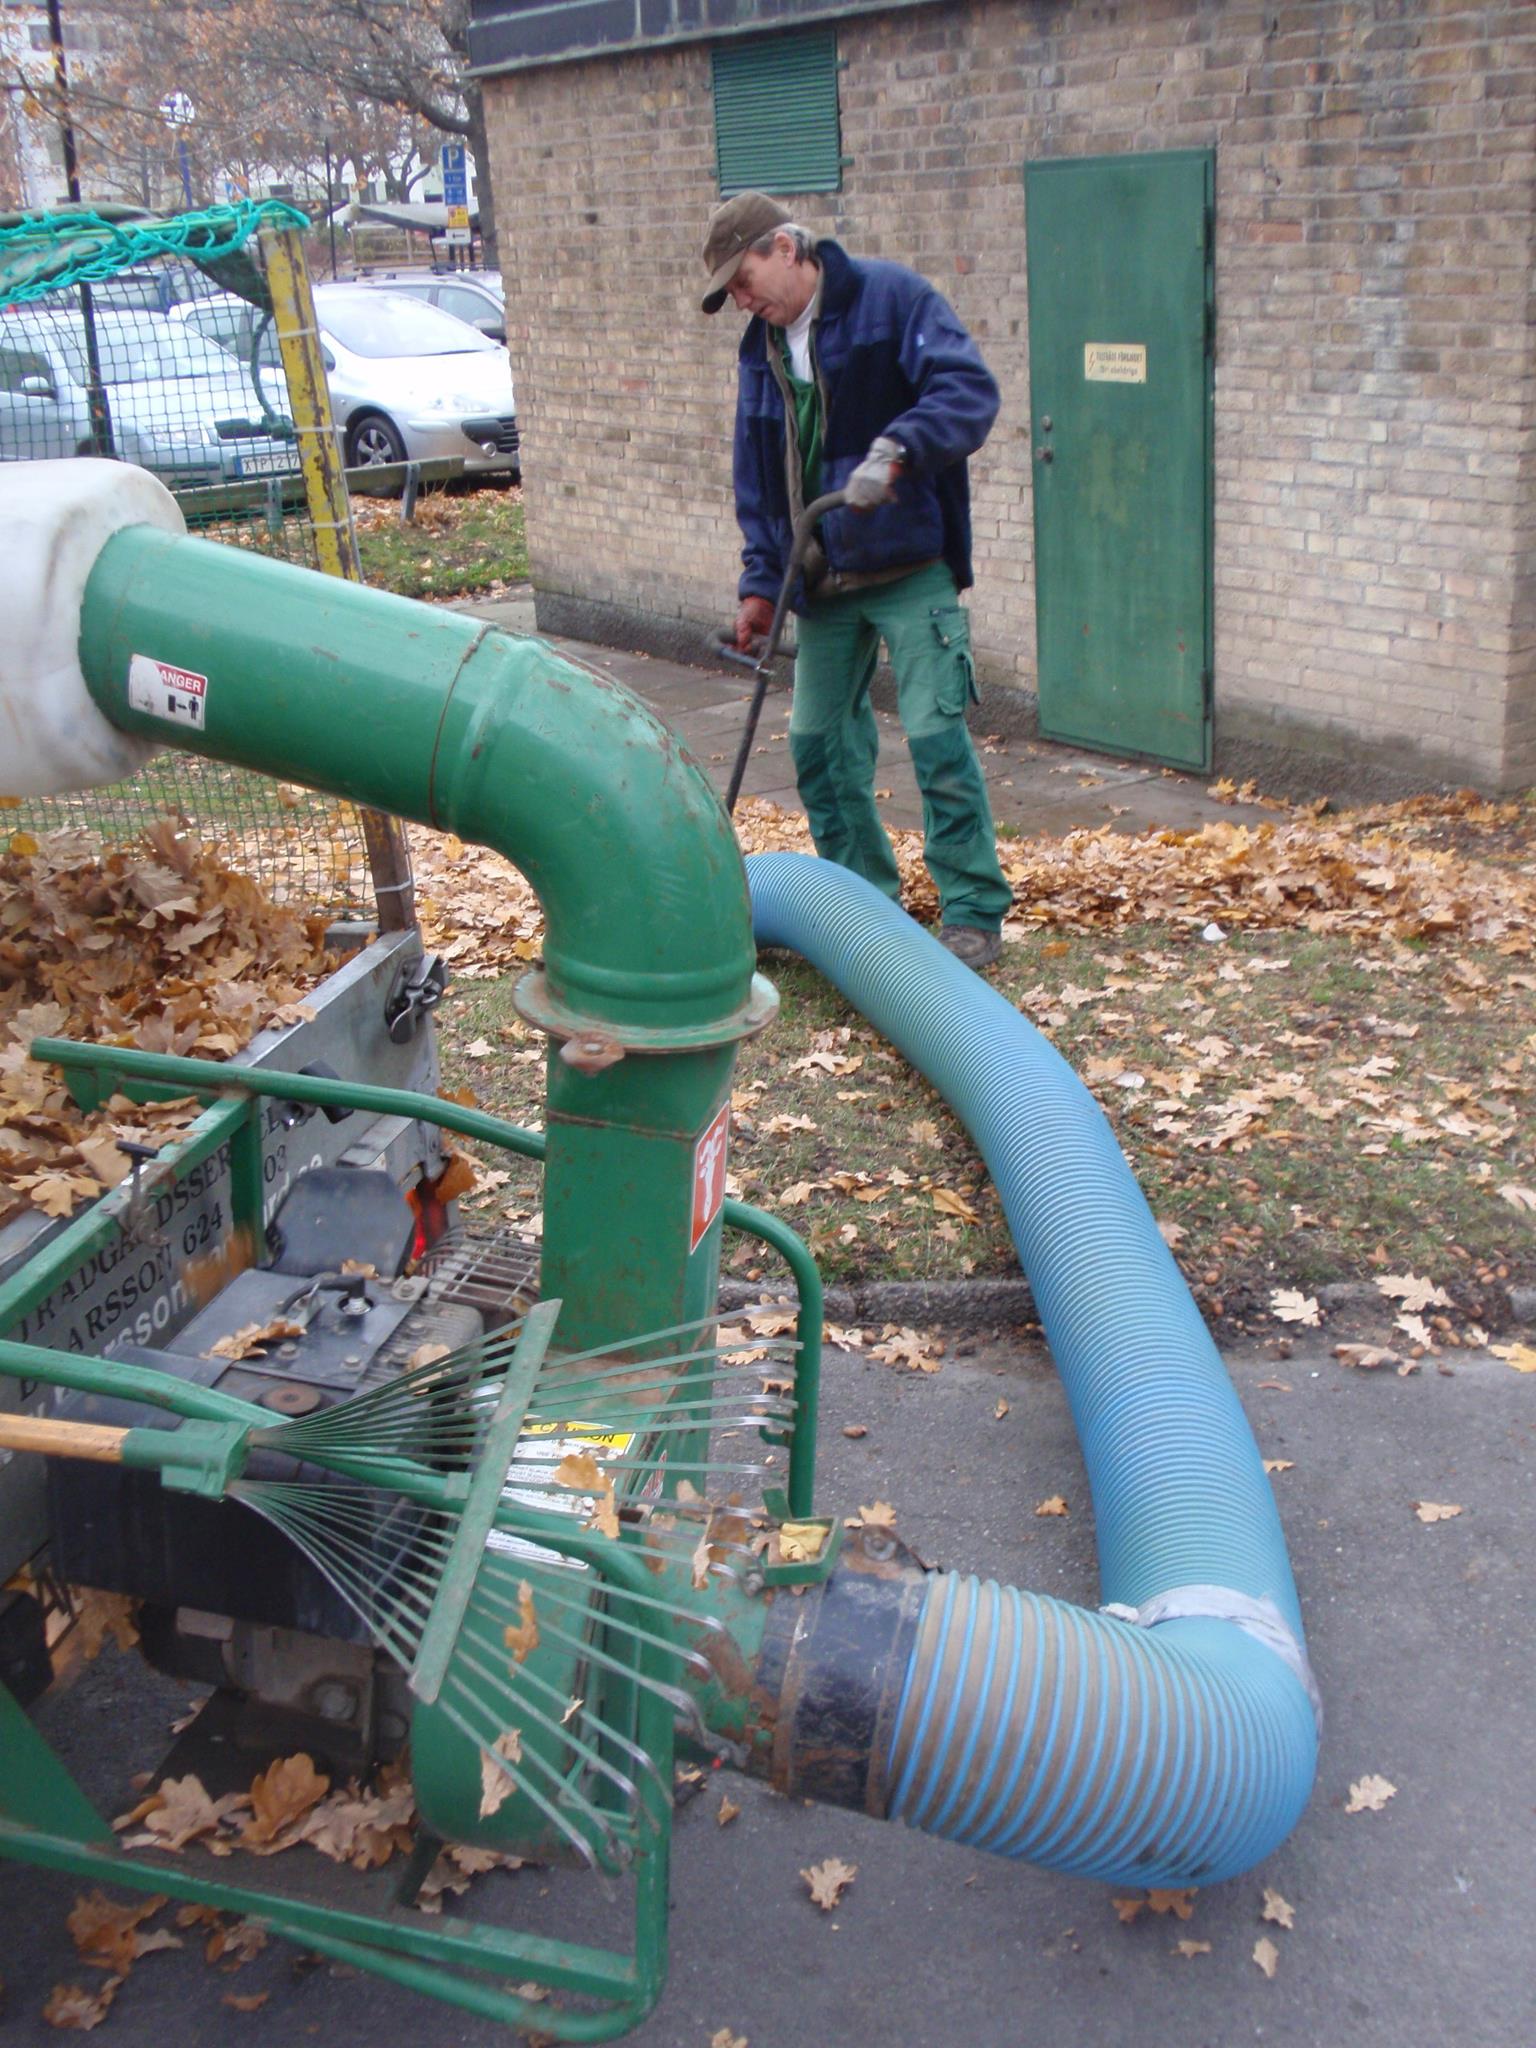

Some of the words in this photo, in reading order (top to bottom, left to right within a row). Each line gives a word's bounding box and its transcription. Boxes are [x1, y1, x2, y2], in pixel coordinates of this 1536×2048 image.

[448, 146, 459, 169] P
[277, 453, 298, 469] 27
[160, 669, 202, 694] ANGER
[47, 1242, 172, 1353] ARSSON
[183, 1201, 222, 1255] 624
